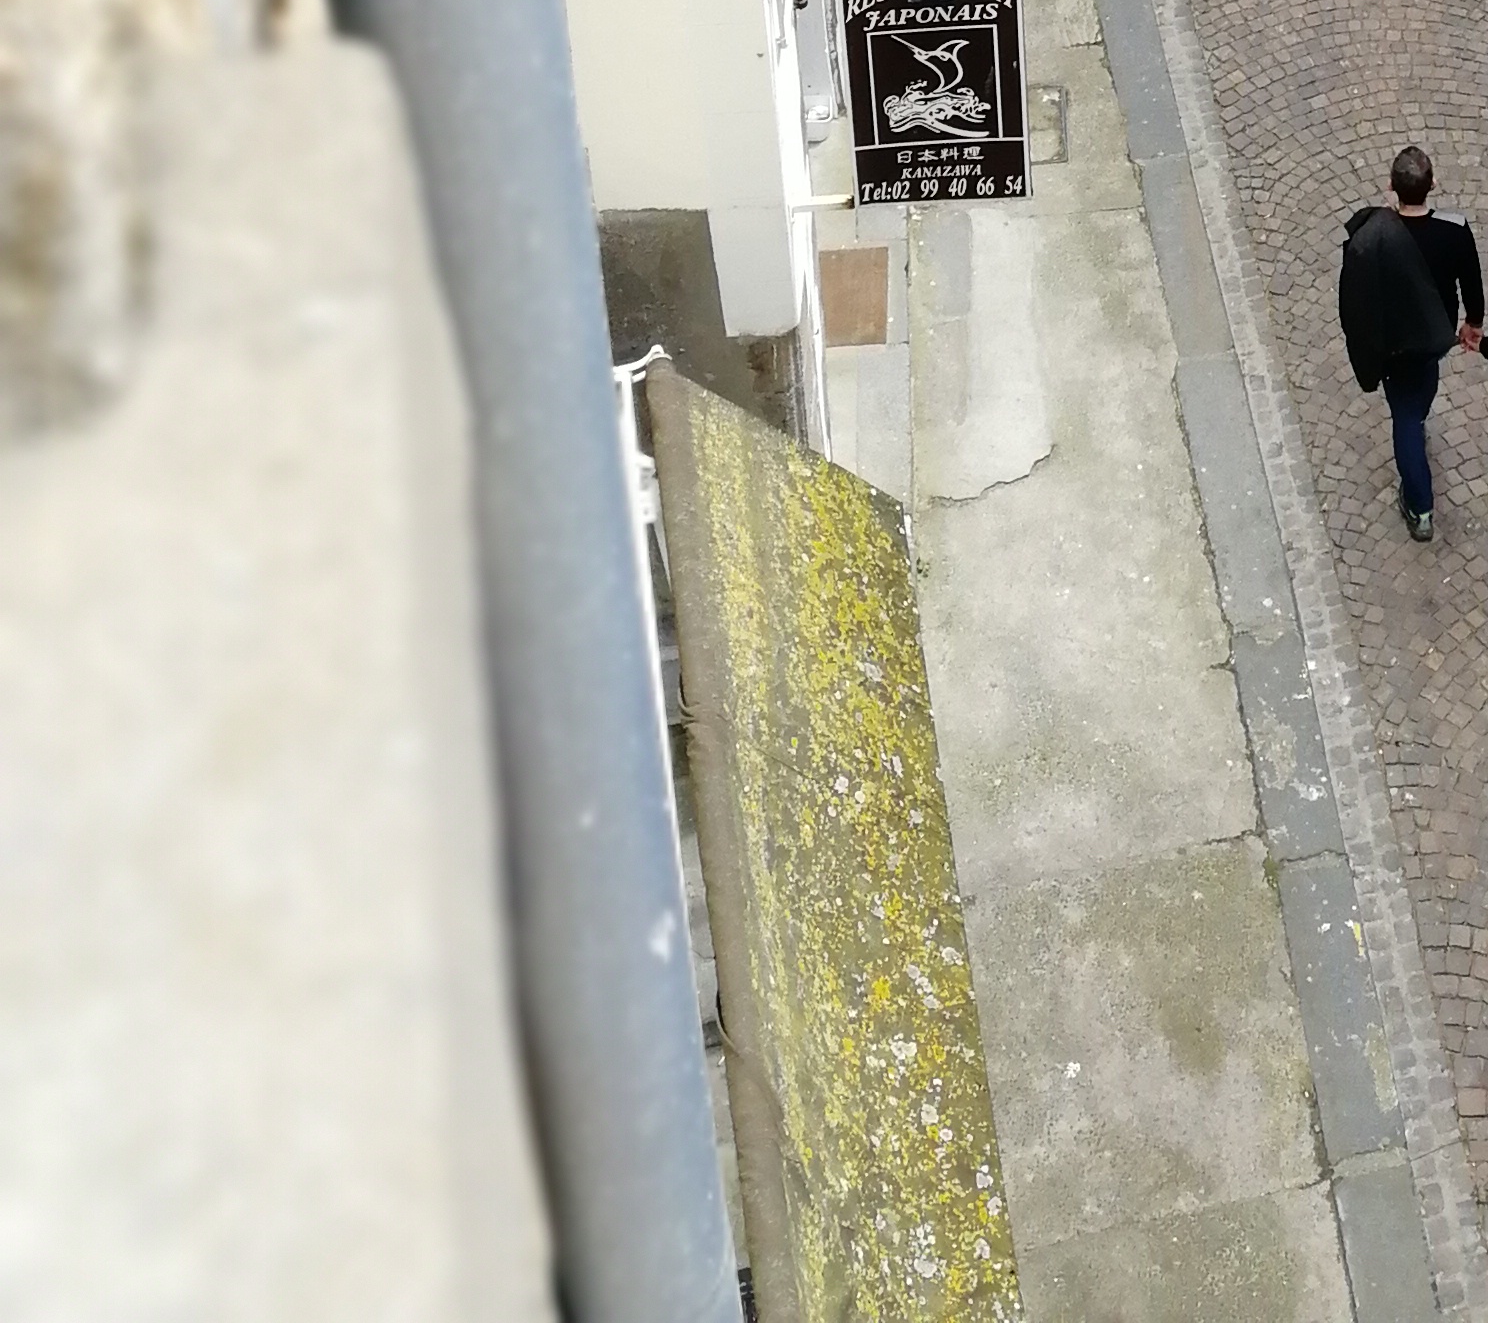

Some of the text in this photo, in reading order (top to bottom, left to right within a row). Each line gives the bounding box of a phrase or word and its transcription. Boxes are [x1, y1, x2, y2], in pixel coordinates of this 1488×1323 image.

[863, 3, 999, 32] JAPONAIS
[896, 145, 984, 164] 日本料理
[901, 163, 983, 180] KANAZAWA
[920, 178, 940, 198] 99
[948, 177, 968, 197] 40
[976, 176, 995, 196] 66
[1004, 174, 1024, 195] 54
